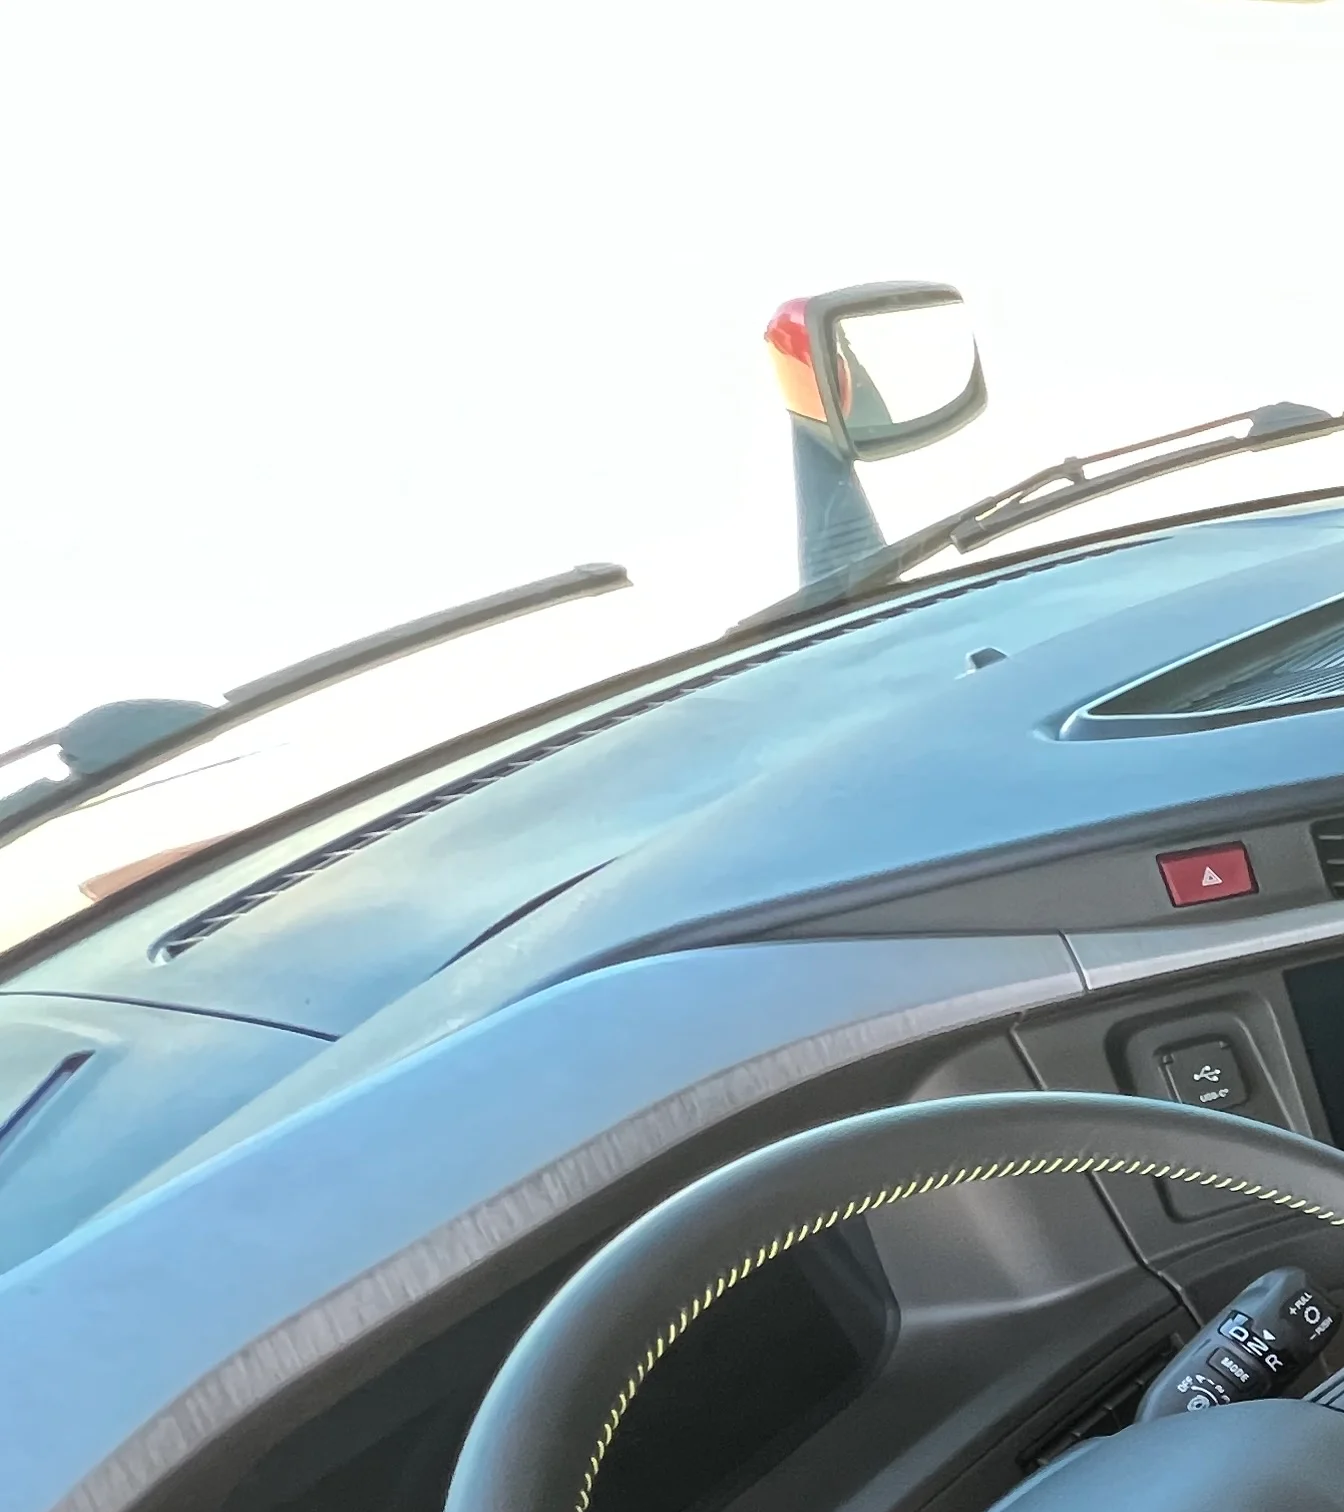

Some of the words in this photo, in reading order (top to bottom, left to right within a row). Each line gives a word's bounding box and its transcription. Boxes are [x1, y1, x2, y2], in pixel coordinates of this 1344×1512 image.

[1229, 1326, 1249, 1342] D
[1246, 1336, 1269, 1357] N
[1220, 1356, 1250, 1383] MODE
[1264, 1354, 1284, 1372] R
